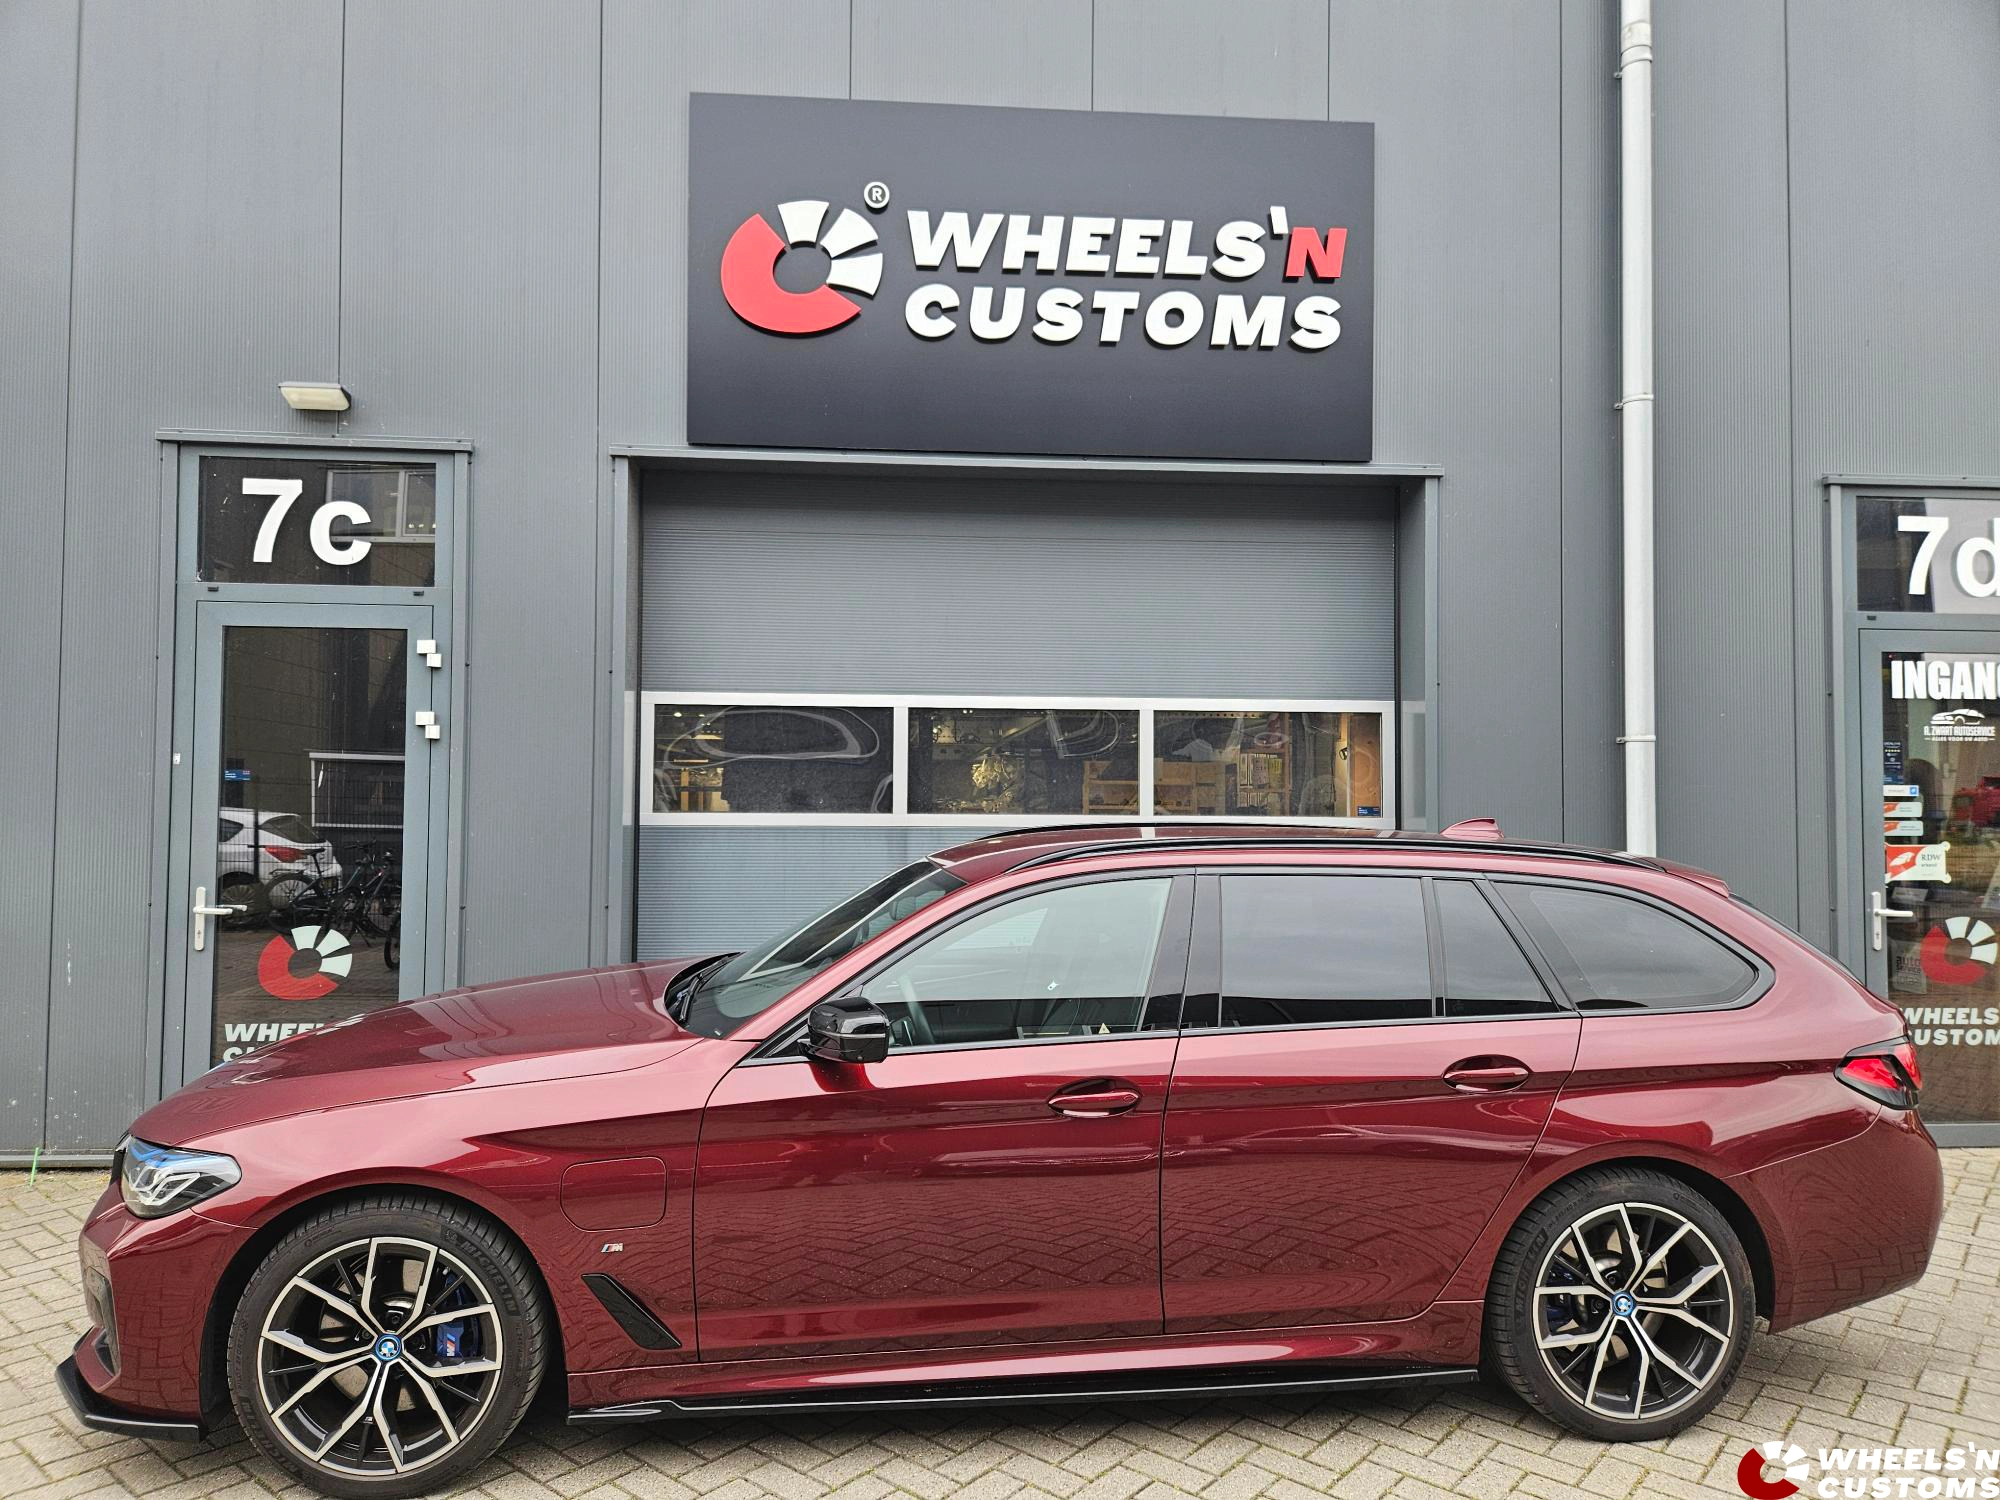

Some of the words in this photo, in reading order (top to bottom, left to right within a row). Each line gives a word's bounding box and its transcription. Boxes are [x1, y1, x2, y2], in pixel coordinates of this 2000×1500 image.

[907, 205, 1348, 278] WHEELS'N
[904, 283, 1341, 349] CUSTOMS
[1907, 1028, 2000, 1046] USTOM
[461, 1240, 518, 1311] MICHELIN
